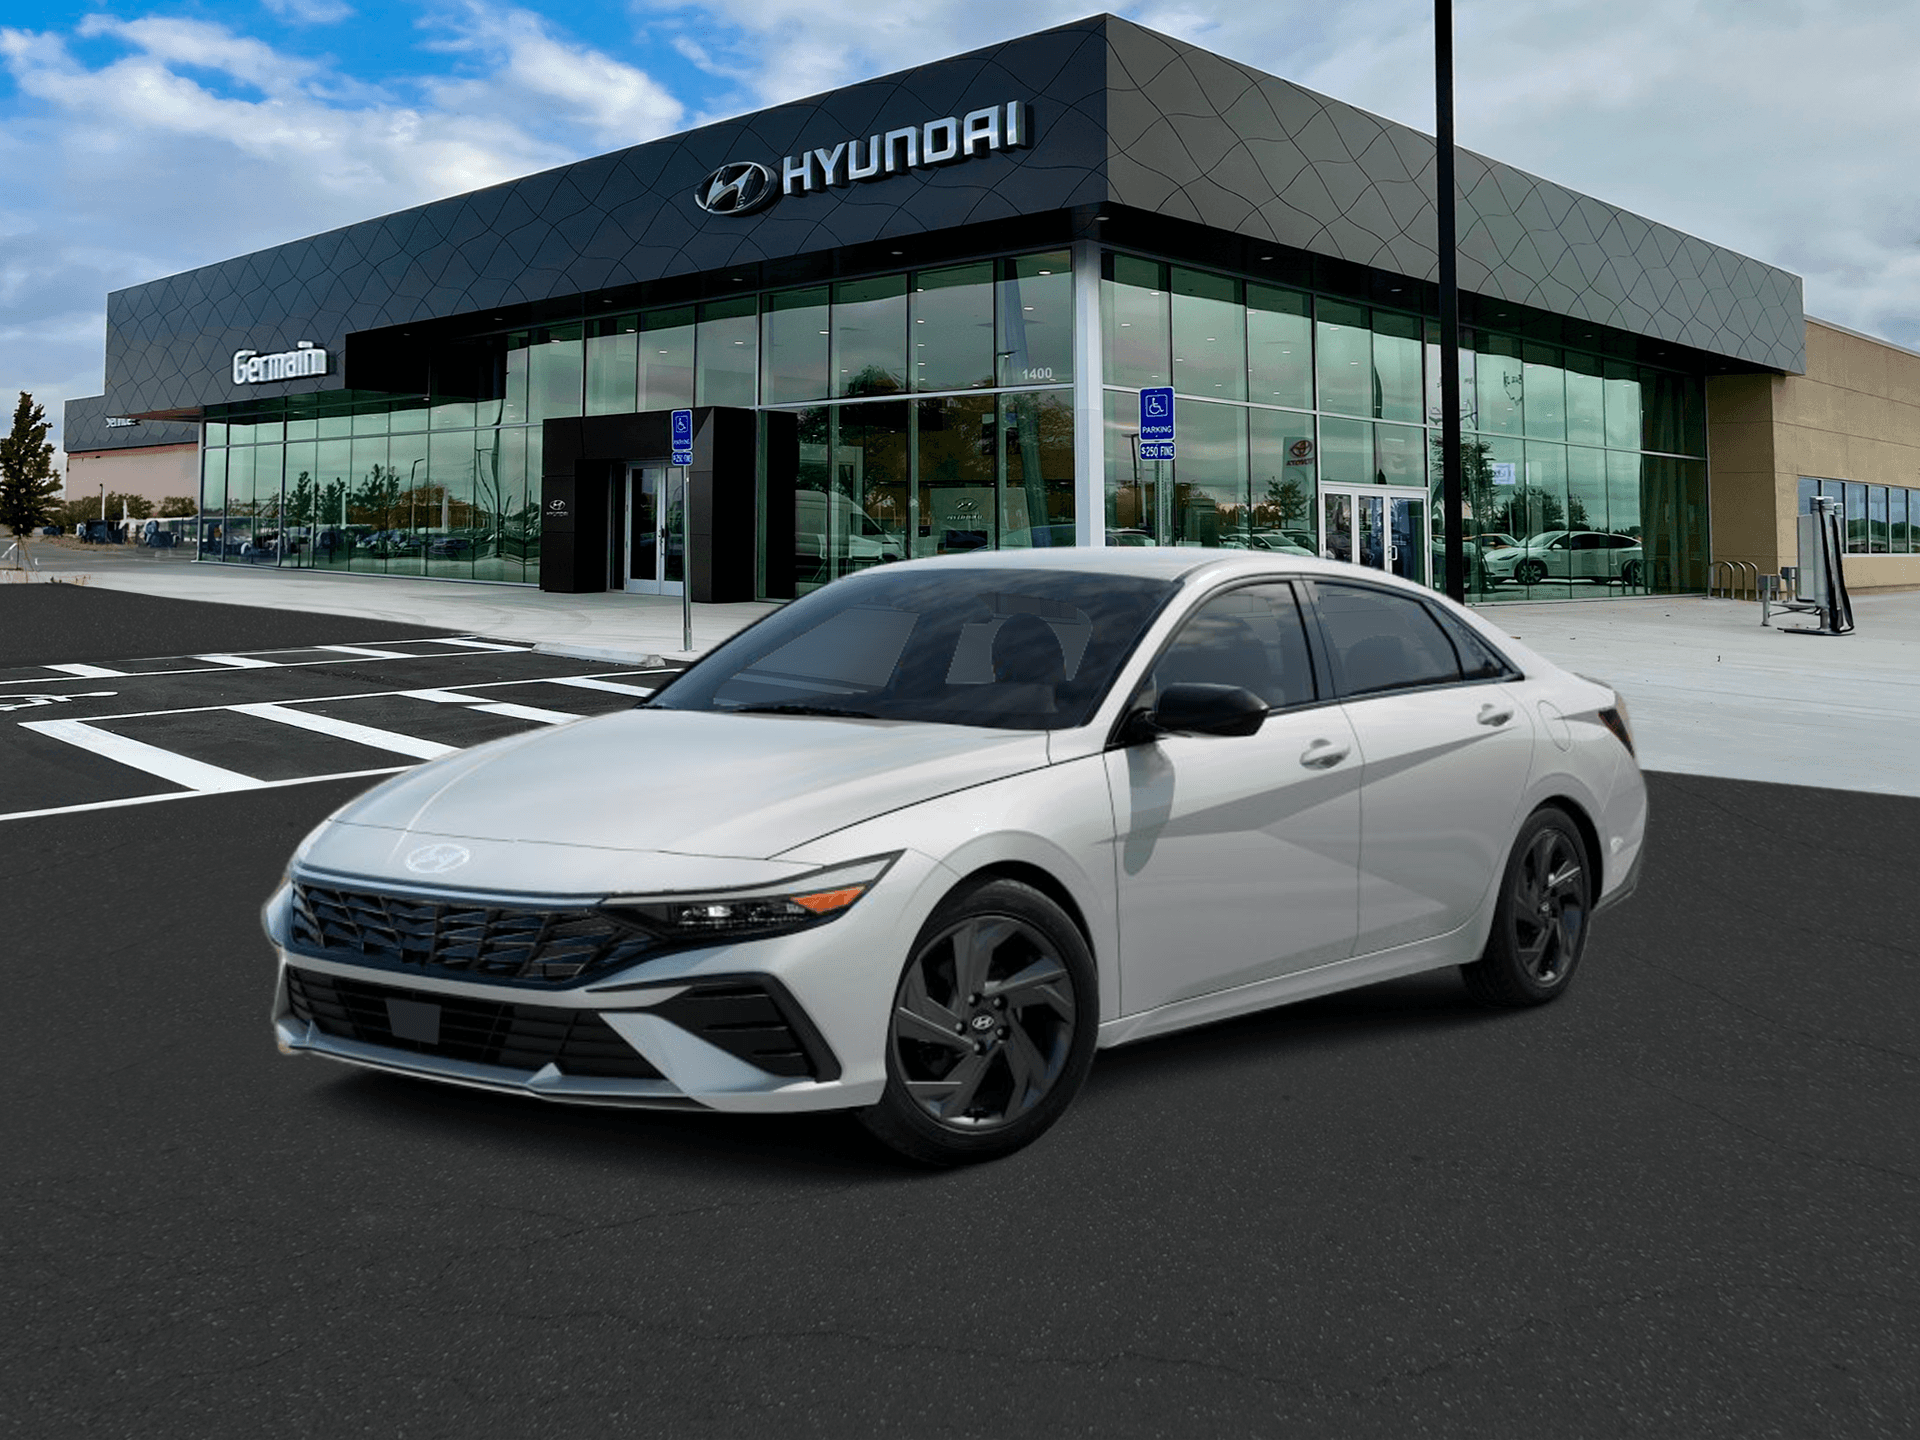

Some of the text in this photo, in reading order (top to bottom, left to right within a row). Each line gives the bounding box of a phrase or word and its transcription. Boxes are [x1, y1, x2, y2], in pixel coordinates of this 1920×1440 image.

[782, 99, 1025, 196] HYUNDAI
[233, 340, 328, 385] Germain
[1022, 367, 1053, 380] 1400
[1142, 425, 1172, 434] PARKING
[1160, 446, 1174, 457] FINE
